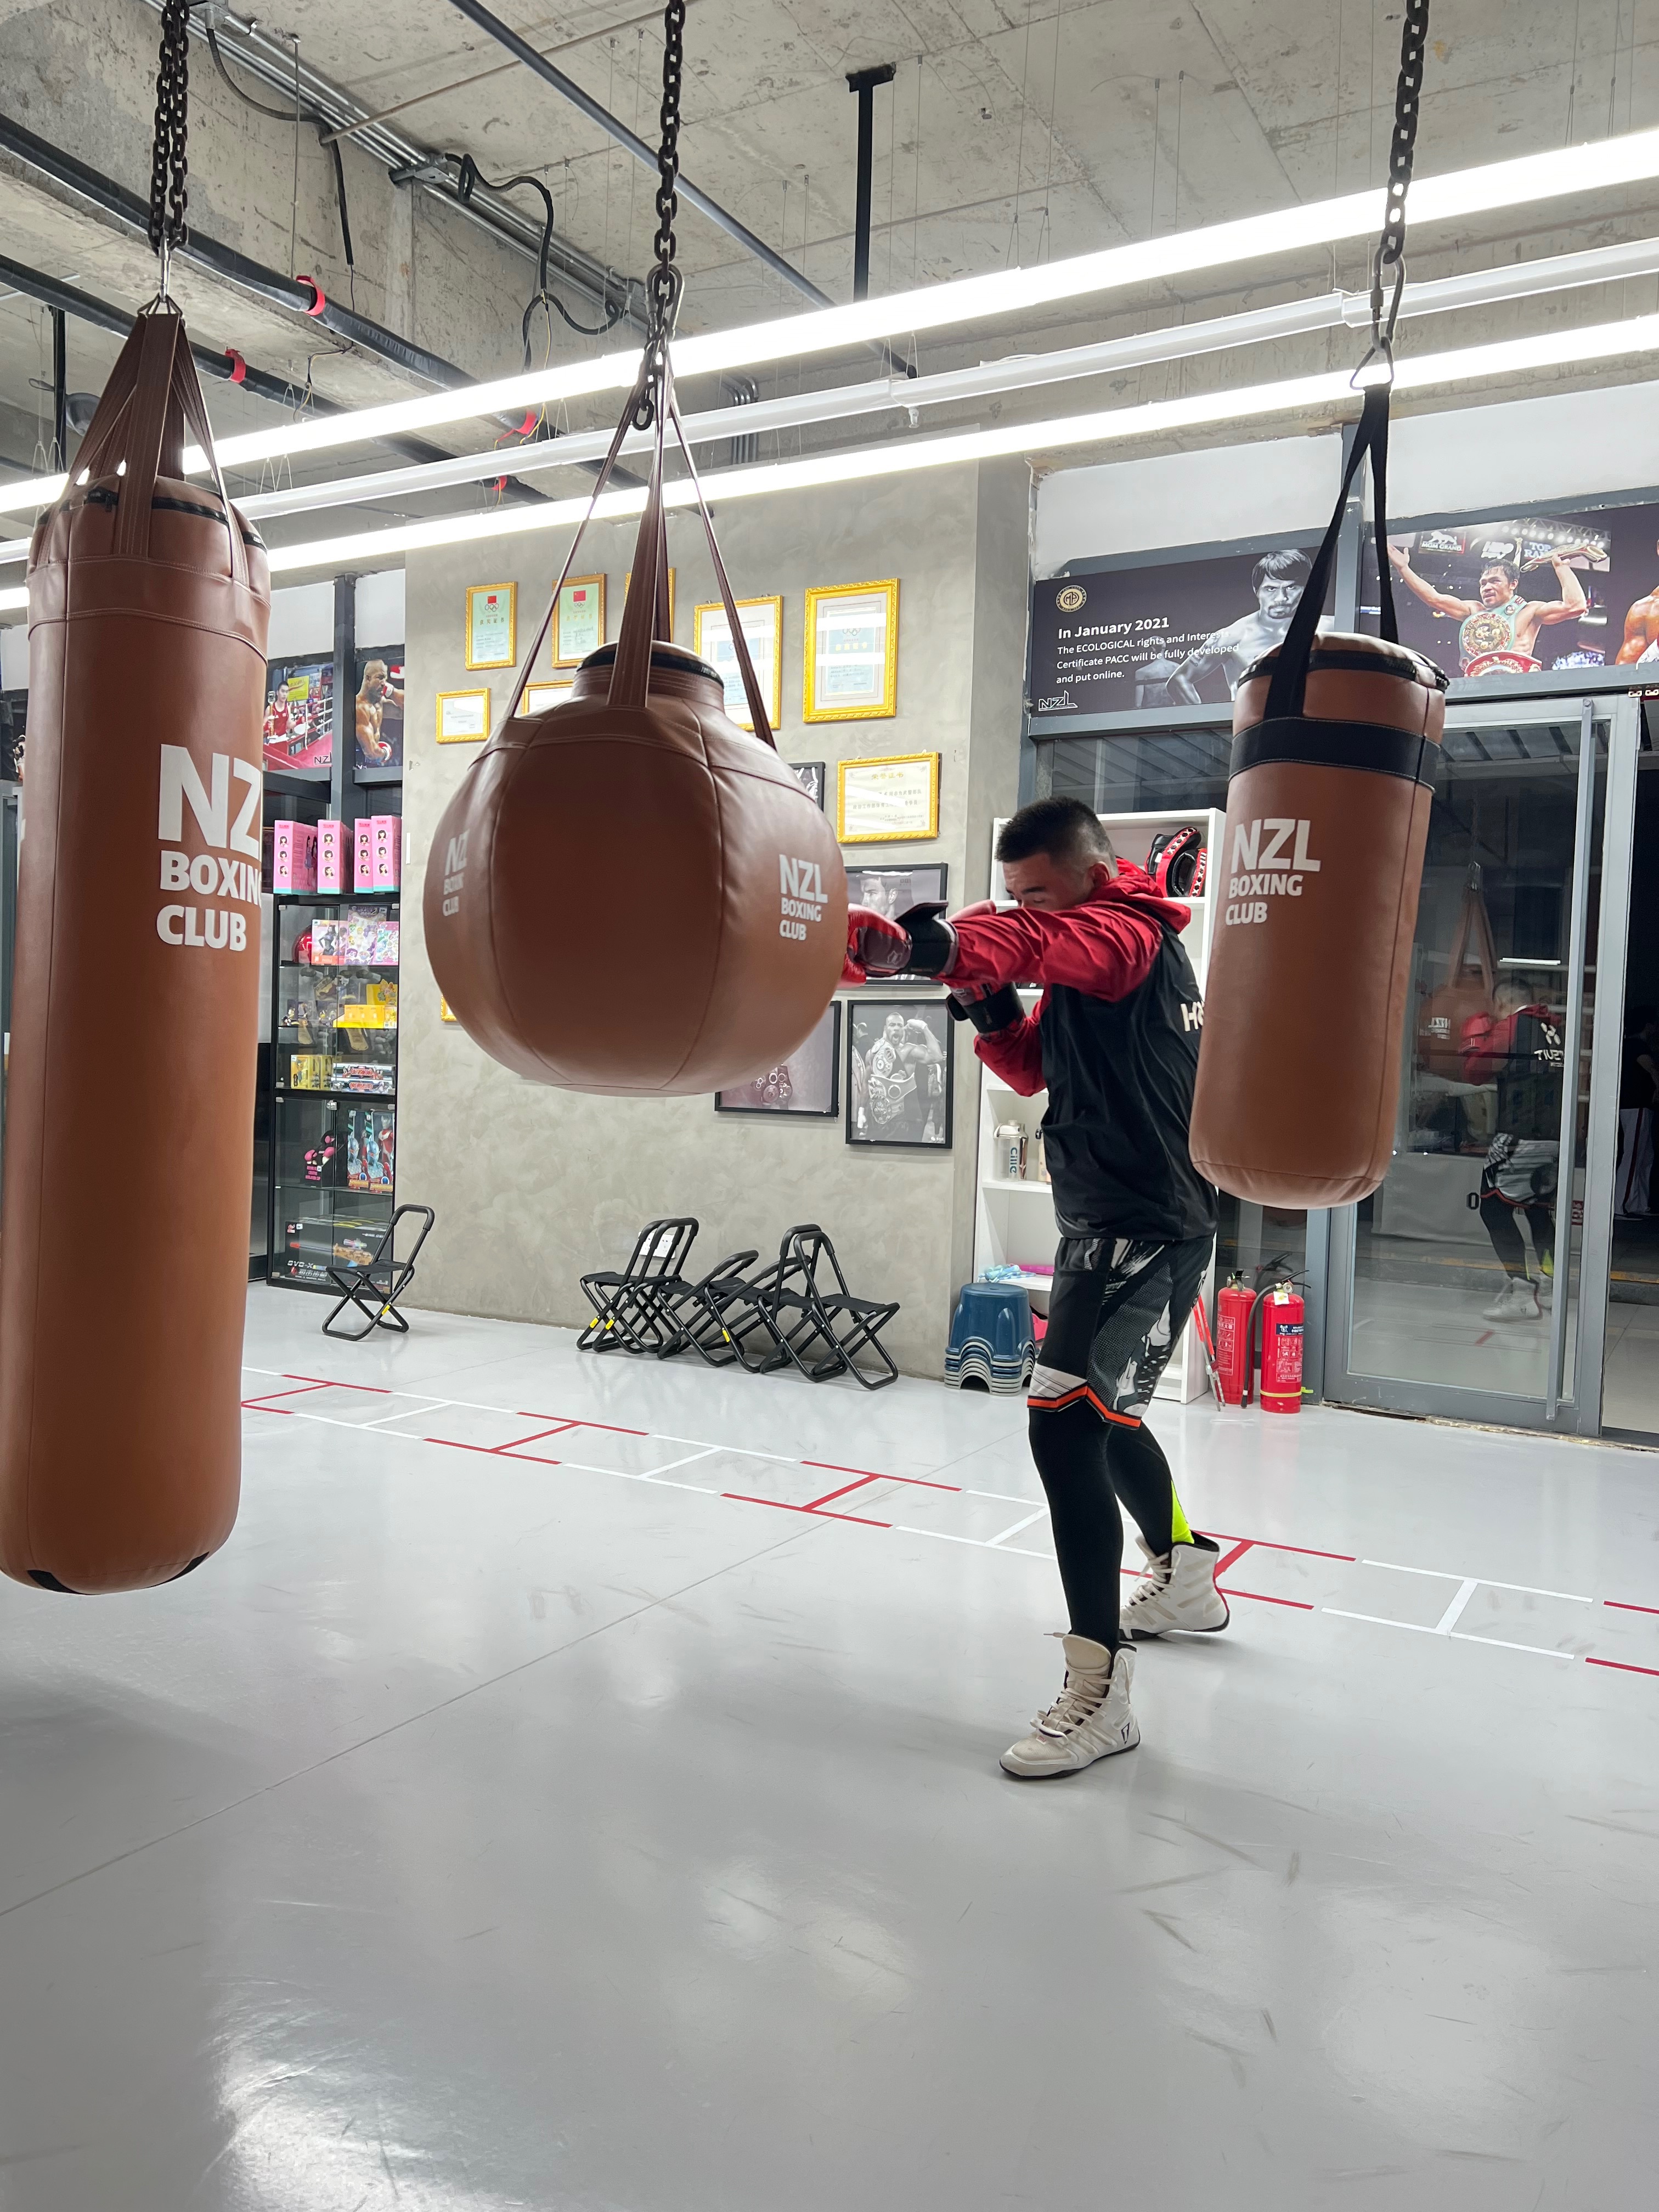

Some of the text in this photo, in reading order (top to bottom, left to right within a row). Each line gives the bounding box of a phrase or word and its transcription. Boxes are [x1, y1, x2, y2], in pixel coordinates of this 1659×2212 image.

[1529, 541, 1551, 552] TOP
[1058, 617, 1170, 639] In January 2021
[1057, 631, 1229, 655] The ECOLOGICAL rights and Interests
[1057, 644, 1239, 669] Certificate PACC will be fully developed
[1056, 670, 1125, 684] and put online.
[1039, 690, 1078, 712] NZL
[1231, 818, 1321, 874] NZL
[160, 850, 262, 908] BOXIN
[779, 854, 828, 904] NZL
[1228, 873, 1304, 899] BOXING
[781, 897, 822, 923] BOXING
[1225, 901, 1268, 926] CLUB
[156, 905, 246, 952] CLUB
[779, 919, 807, 941] CLUB
